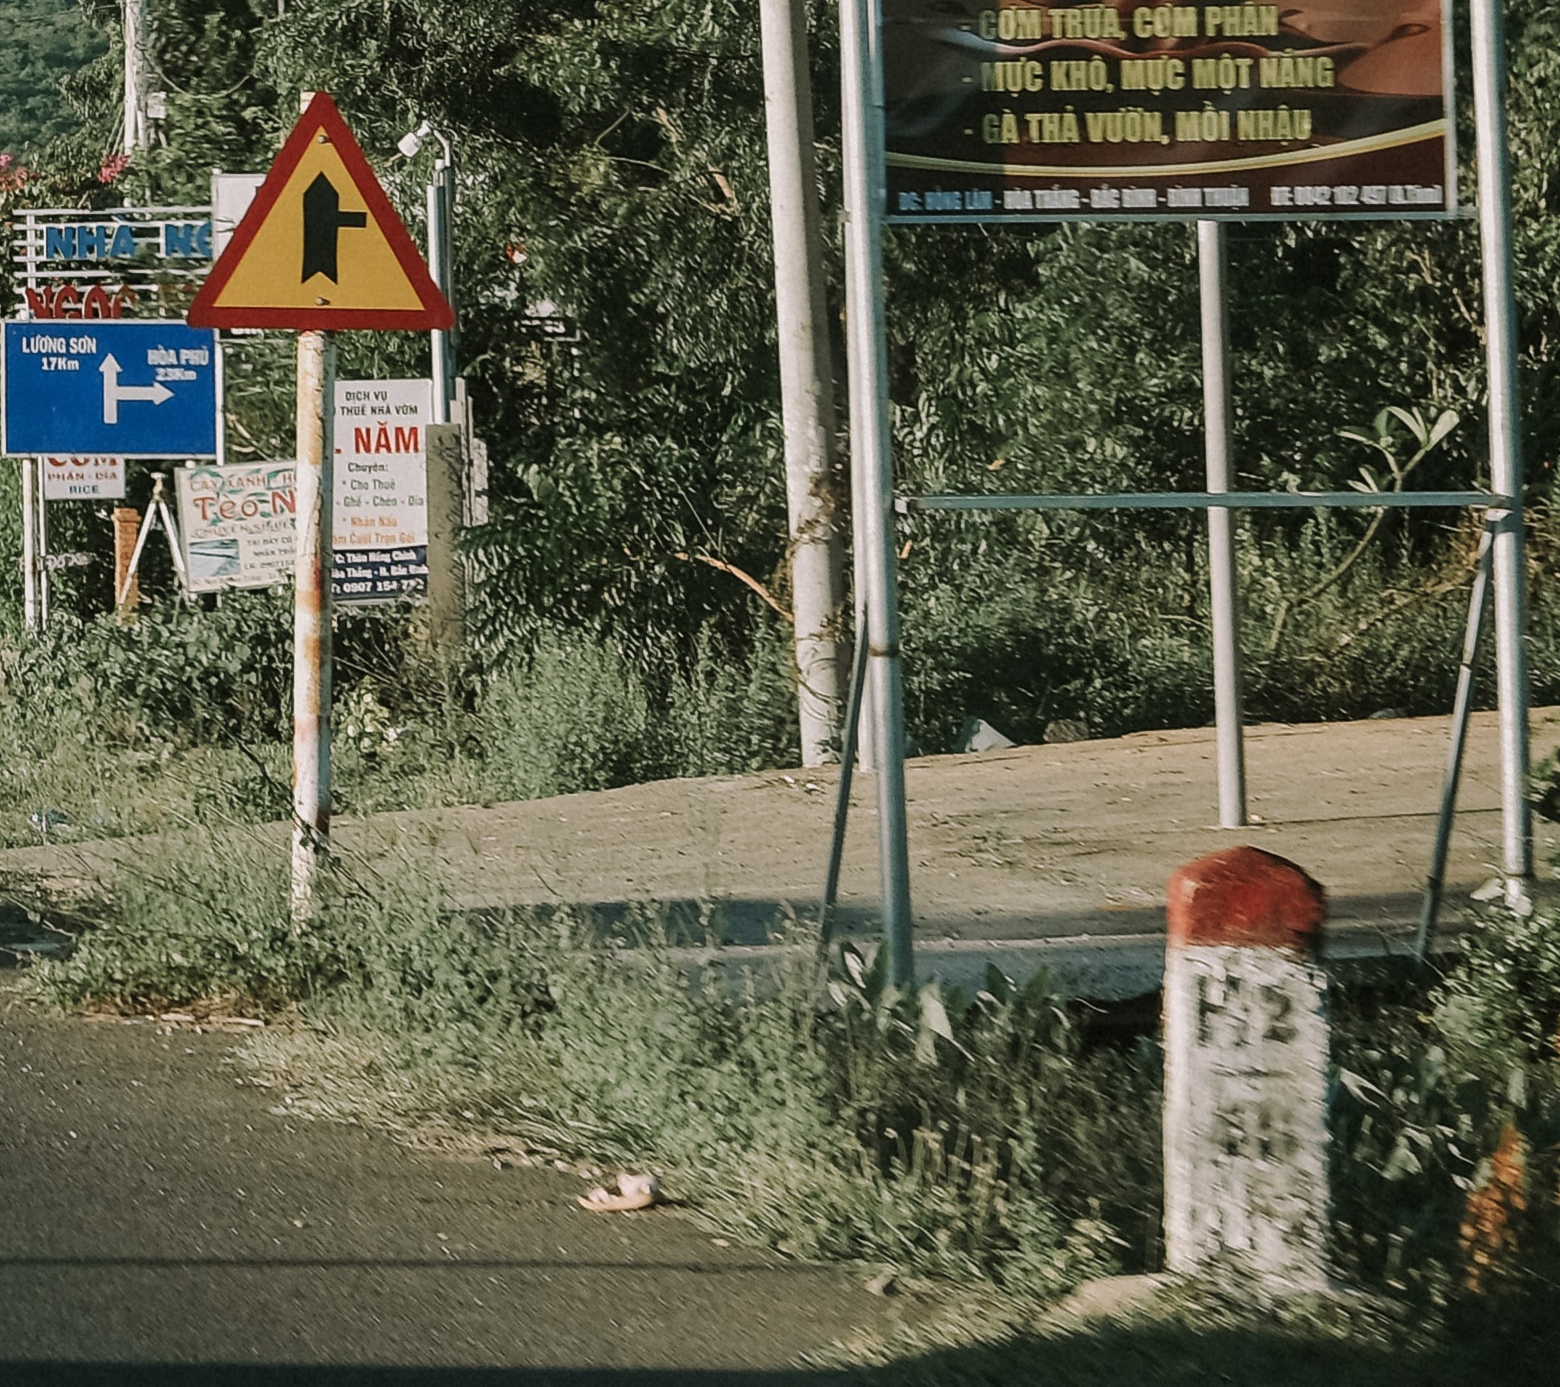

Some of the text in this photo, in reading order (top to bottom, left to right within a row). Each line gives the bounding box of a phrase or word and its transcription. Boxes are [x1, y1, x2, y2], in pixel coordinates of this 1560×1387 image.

[979, 3, 1041, 40] CƠM
[1048, 3, 1127, 41] TRƯA,
[1133, 1, 1198, 38] CƠM
[980, 56, 1043, 97] MỰC
[1050, 54, 1114, 94] KHÔ,
[1121, 54, 1185, 96] MỰC
[1192, 52, 1254, 95] MỘT
[982, 108, 1020, 144] GÀ
[1024, 105, 1080, 143] THẢ
[45, 213, 136, 259] NHÀ
[22, 334, 97, 354] LƯƠNG SƠN
[41, 357, 80, 371] 17Km
[354, 421, 419, 454] NĂM
